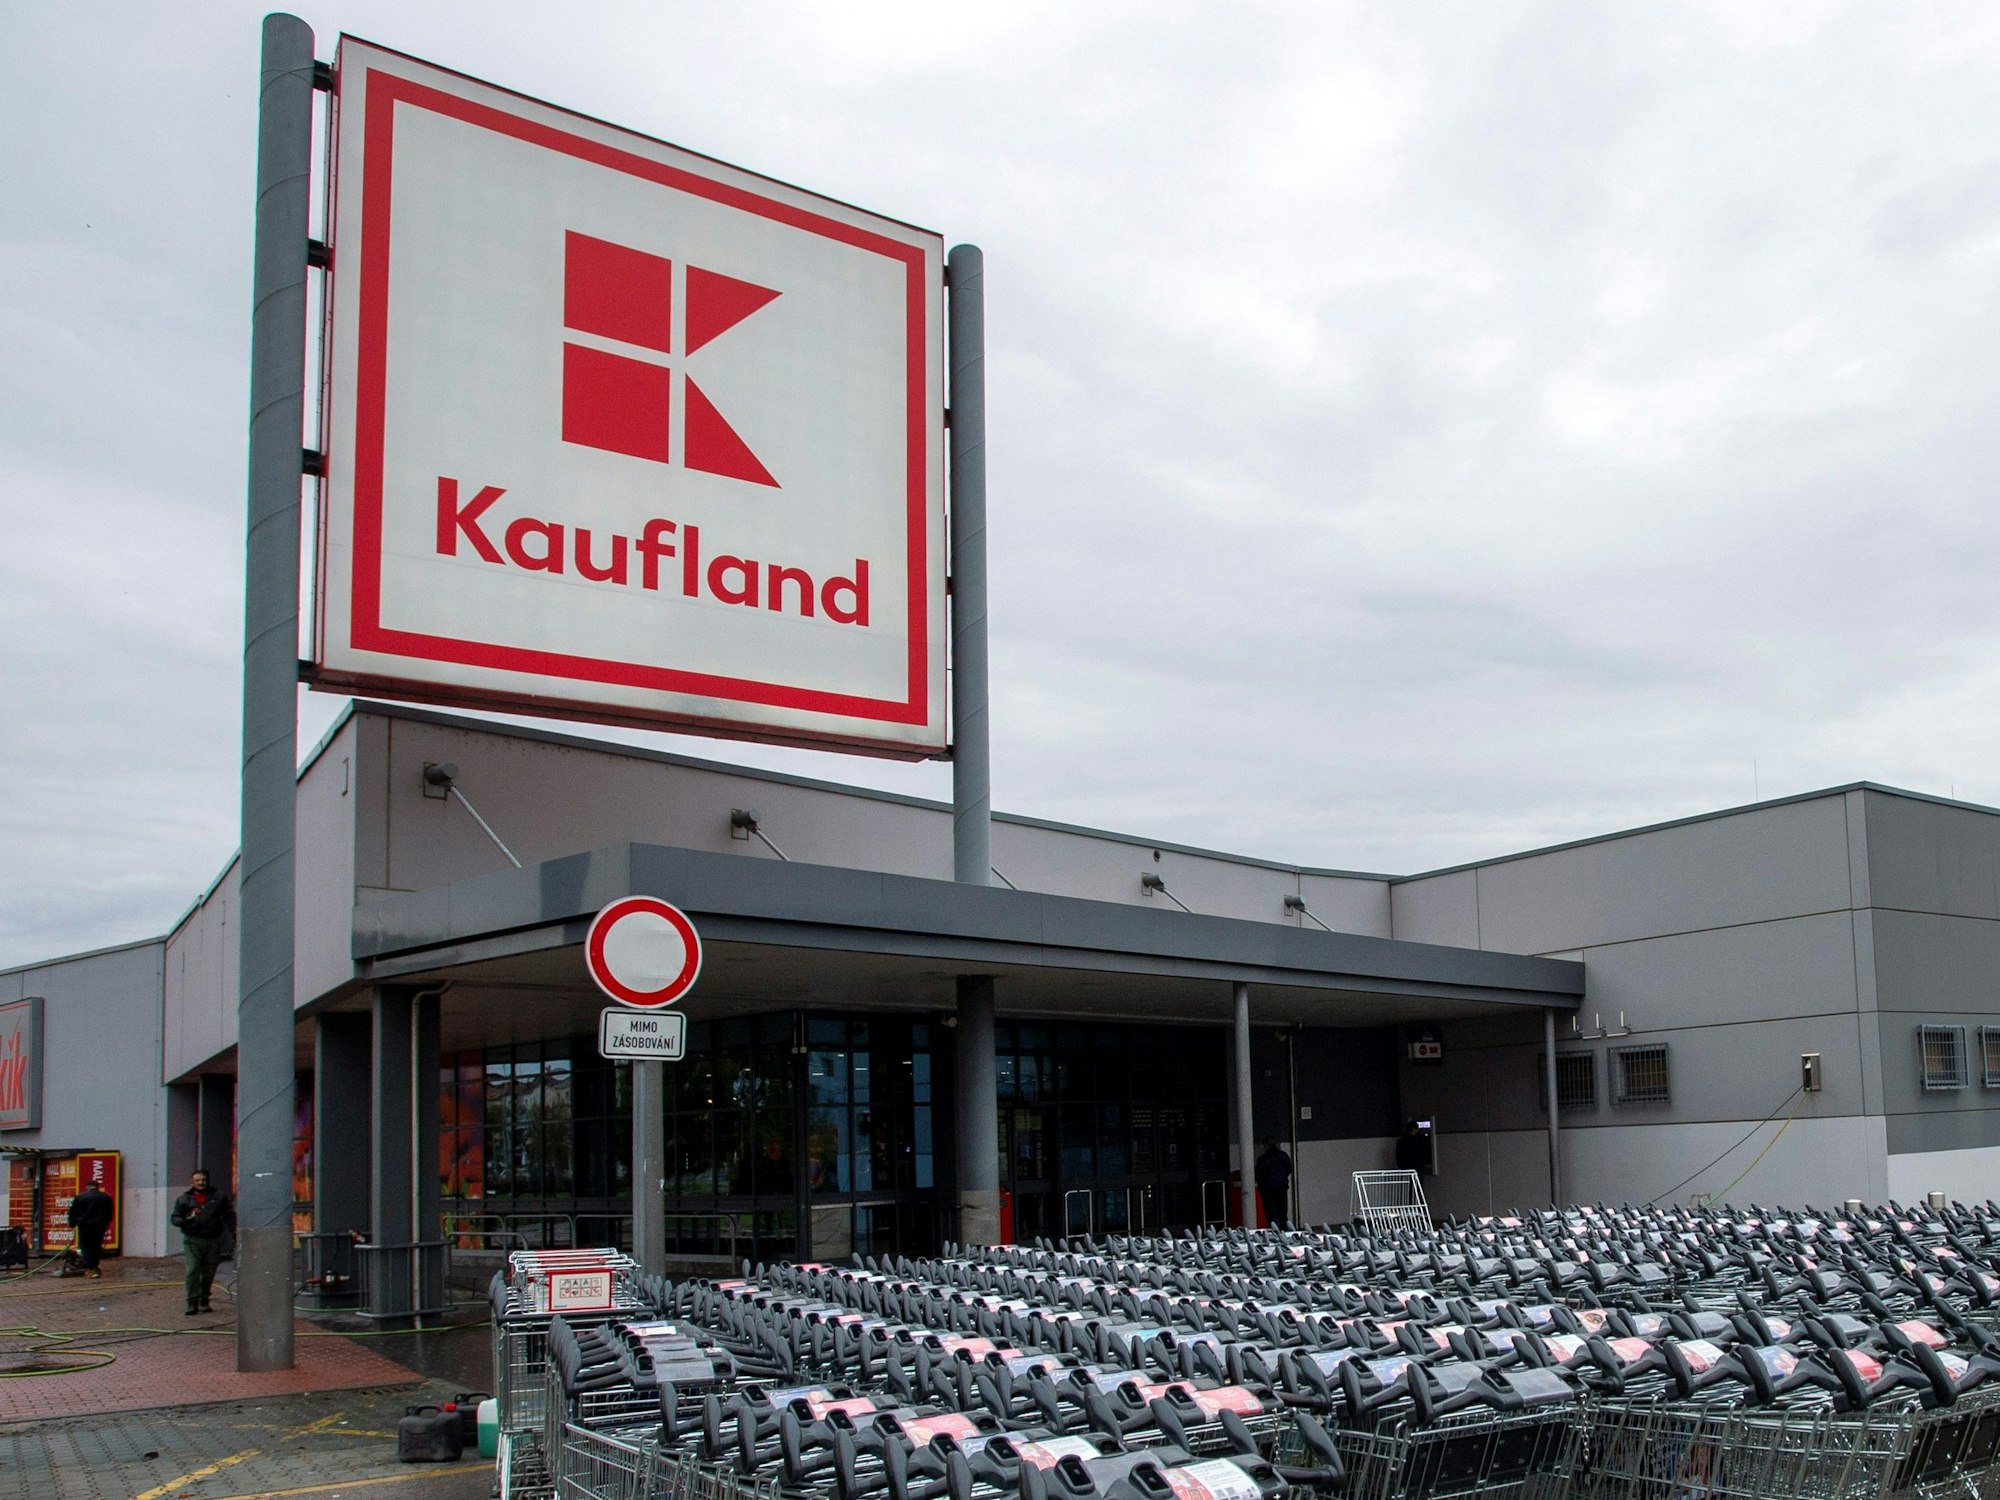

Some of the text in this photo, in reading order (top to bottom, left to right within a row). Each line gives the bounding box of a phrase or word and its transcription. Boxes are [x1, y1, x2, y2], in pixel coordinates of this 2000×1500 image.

[436, 476, 869, 627] Kaufland
[630, 1020, 658, 1033] MIMO
[612, 1034, 676, 1050] ZÁSOBOVÁNÍ
